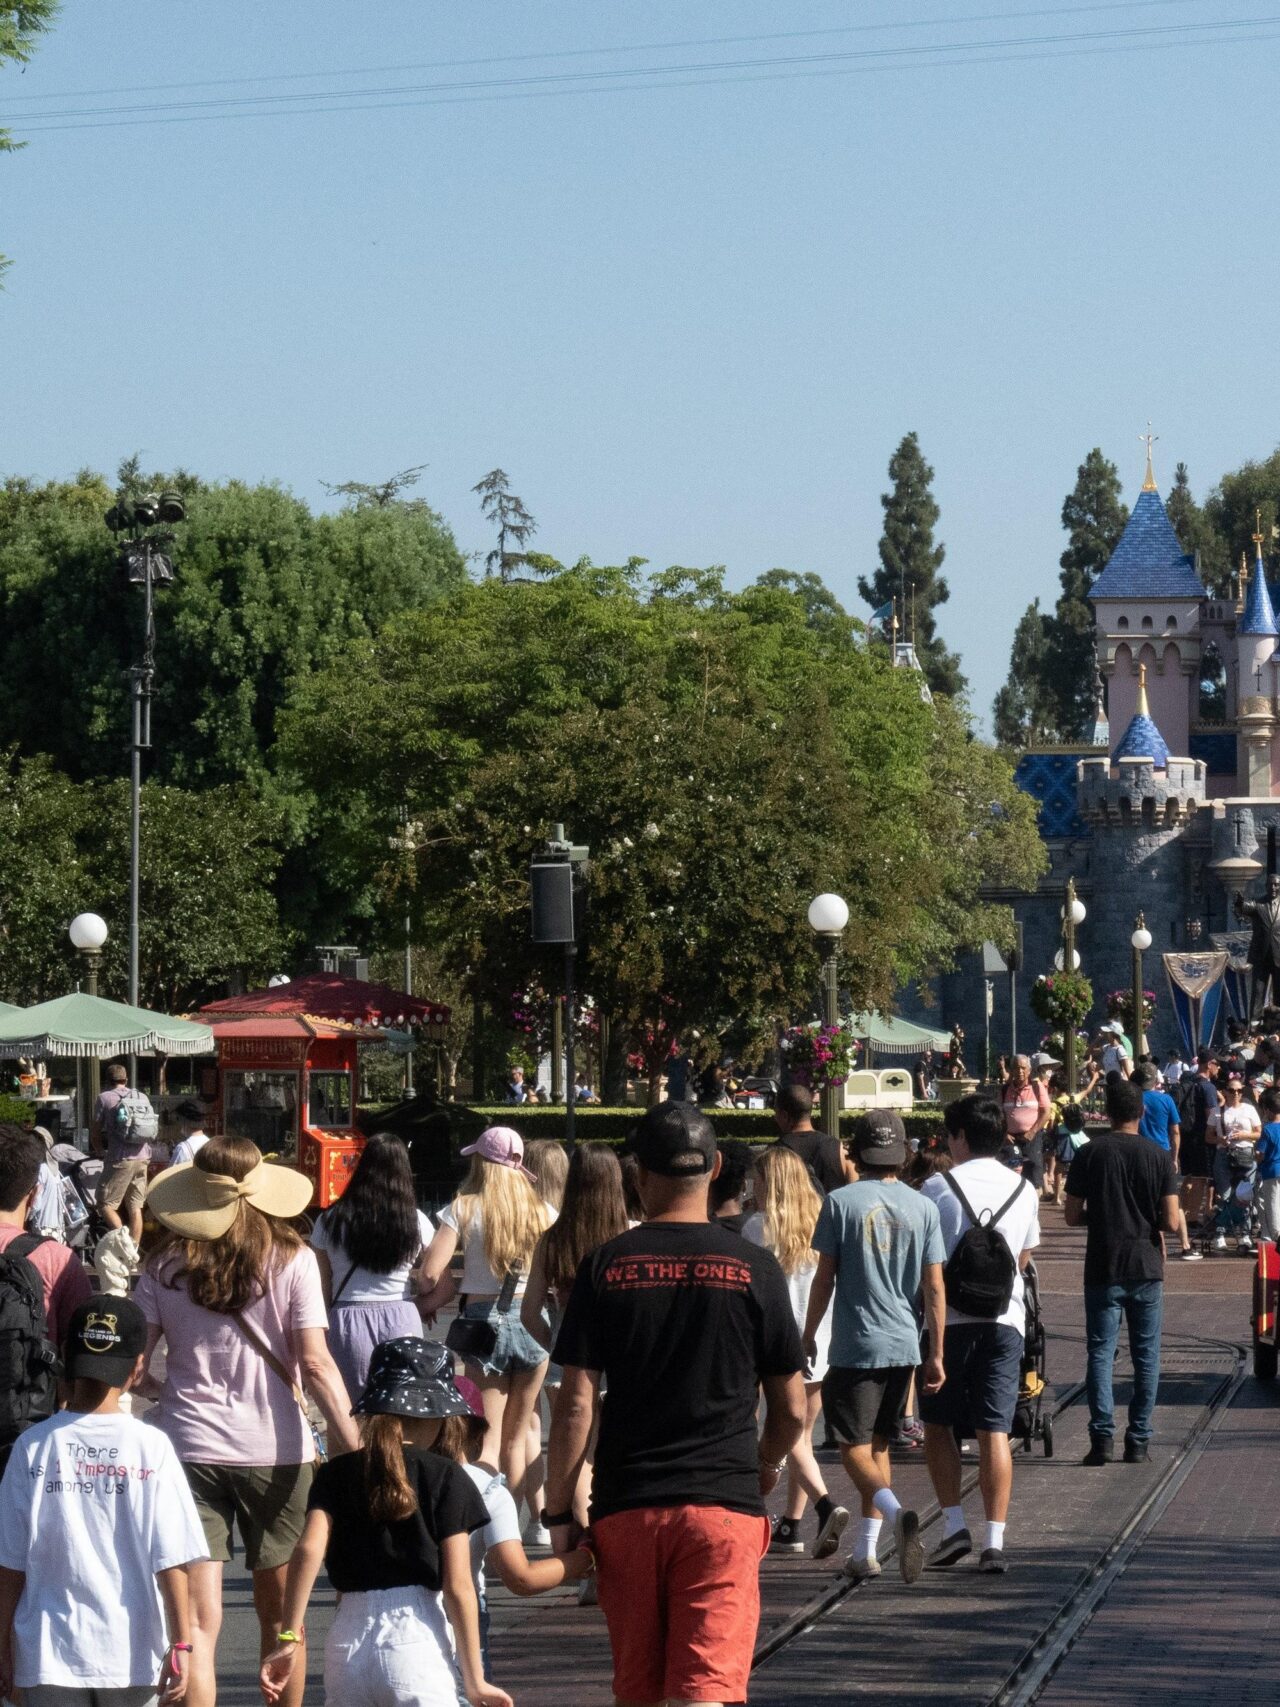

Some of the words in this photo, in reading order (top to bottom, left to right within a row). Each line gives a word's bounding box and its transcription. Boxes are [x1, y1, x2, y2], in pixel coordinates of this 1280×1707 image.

[605, 1264, 638, 1282] WE
[644, 1263, 688, 1279] THE
[694, 1263, 752, 1283] ONES
[78, 1331, 121, 1342] LEGENDS
[66, 1443, 119, 1458] There
[29, 1466, 44, 1479] is
[75, 1462, 156, 1481] Impostor
[45, 1480, 94, 1494] among
[104, 1482, 125, 1495] us
